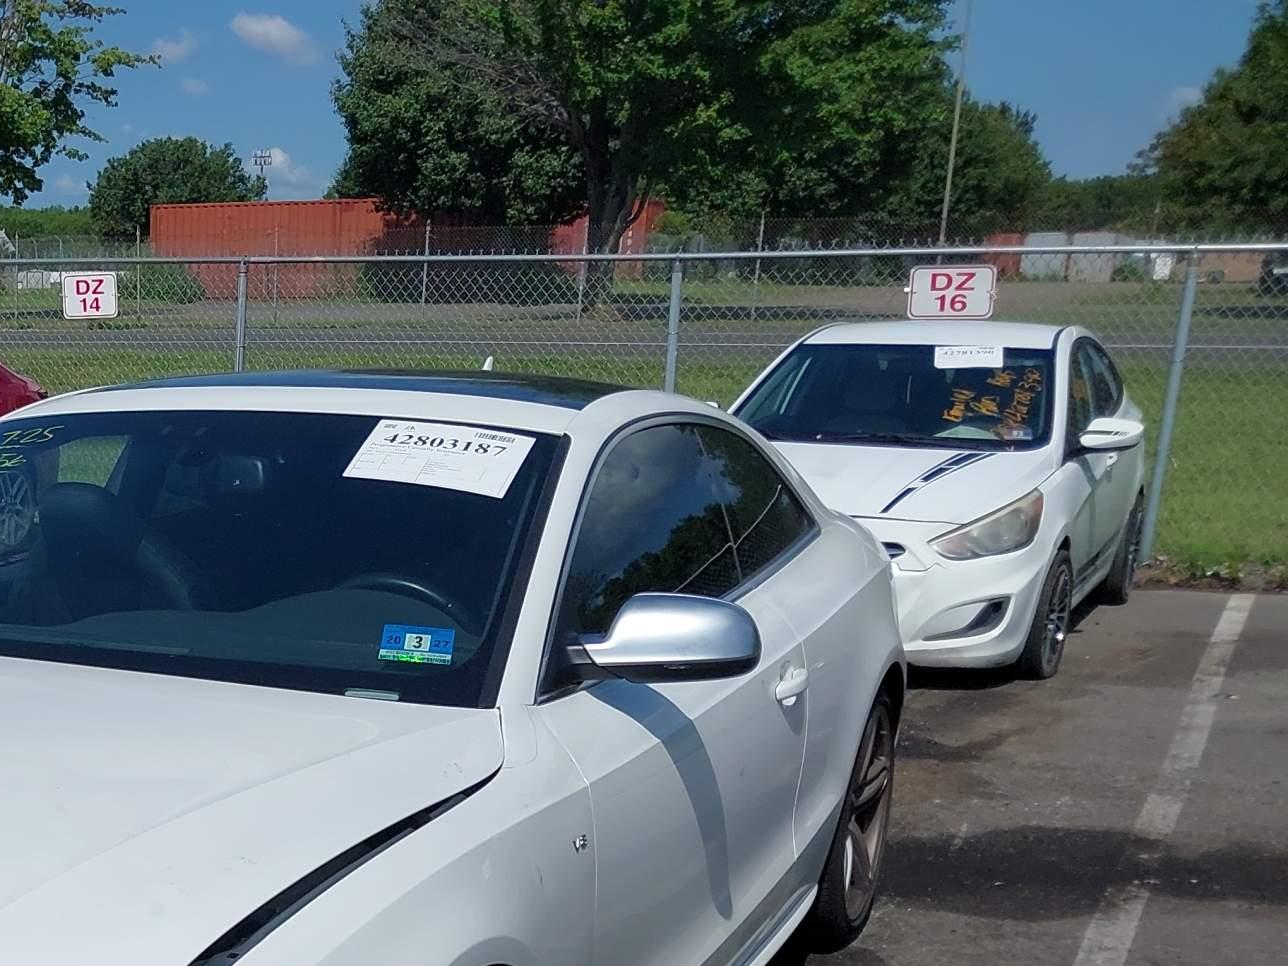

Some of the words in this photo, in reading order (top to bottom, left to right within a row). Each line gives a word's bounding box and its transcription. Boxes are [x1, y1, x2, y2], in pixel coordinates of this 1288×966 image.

[75, 279, 105, 295] DZ
[930, 272, 977, 291] DZ
[79, 297, 101, 312] 14
[935, 294, 968, 312] 16
[383, 433, 507, 456] 42803187
[386, 635, 401, 644] 20
[413, 636, 423, 648] 3
